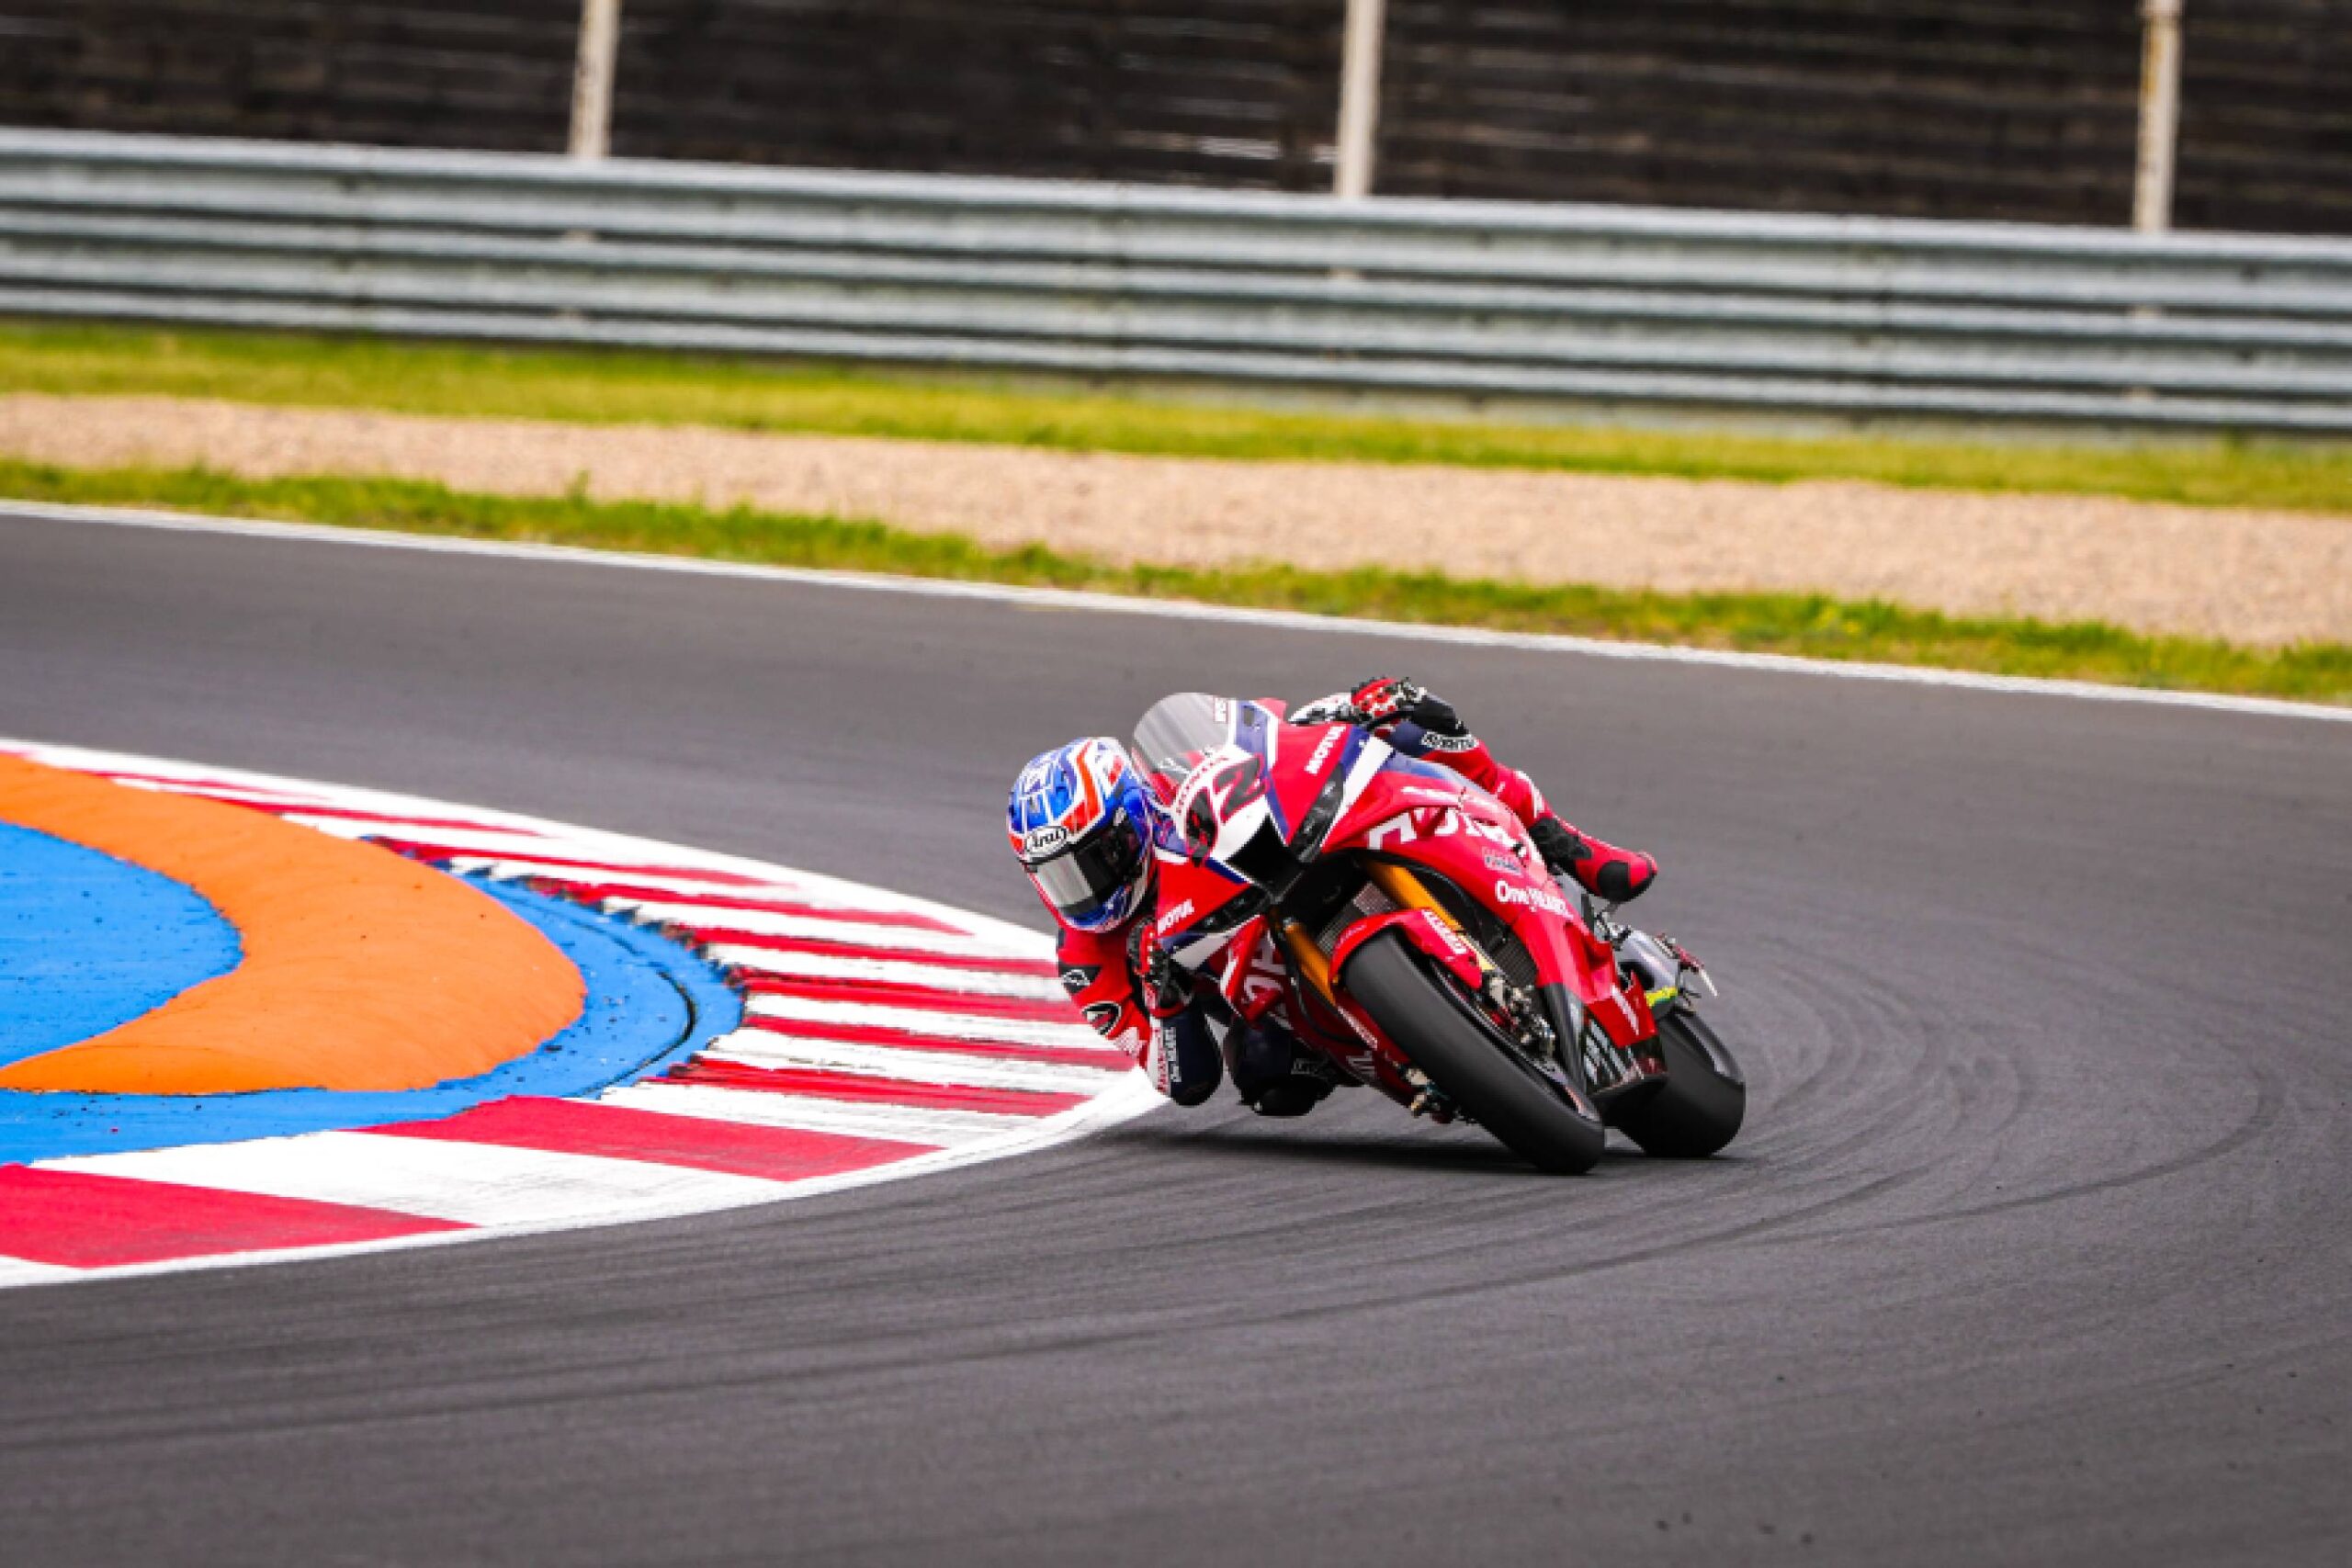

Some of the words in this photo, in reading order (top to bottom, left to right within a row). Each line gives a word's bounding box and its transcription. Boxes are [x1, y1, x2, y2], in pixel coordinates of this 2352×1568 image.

[1304, 726, 1346, 775] MOTUL
[1184, 753, 1270, 868] 92
[1157, 898, 1194, 936] MOTUL
